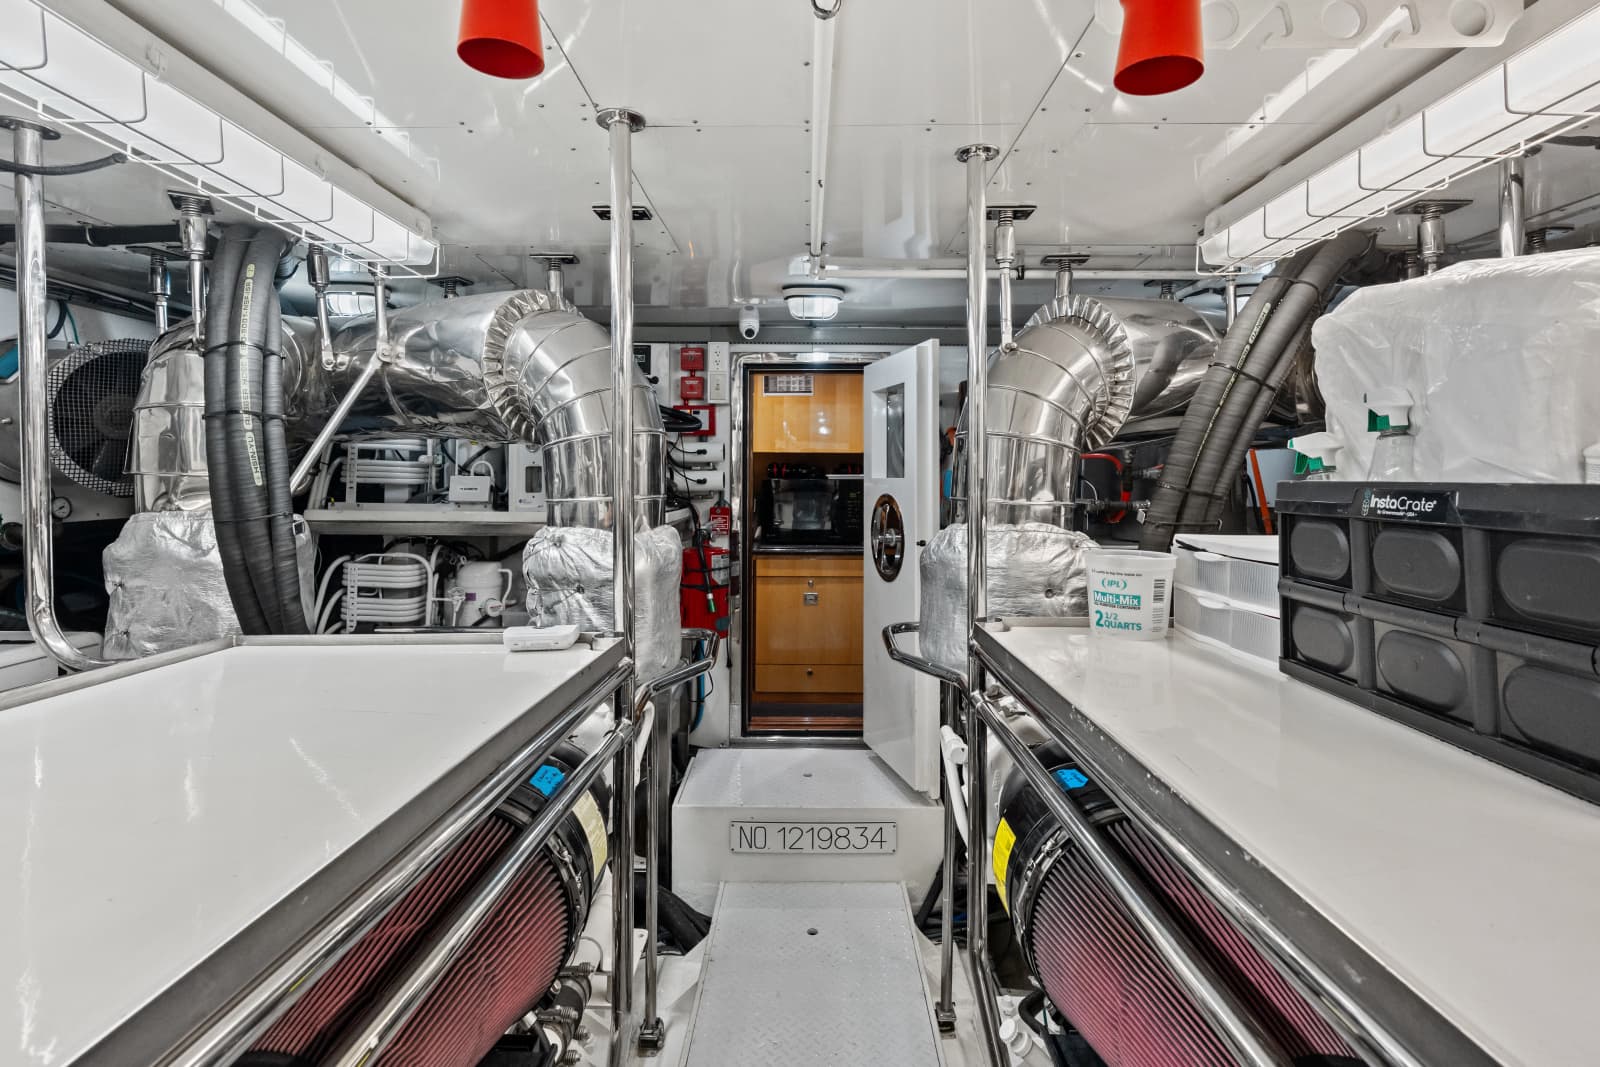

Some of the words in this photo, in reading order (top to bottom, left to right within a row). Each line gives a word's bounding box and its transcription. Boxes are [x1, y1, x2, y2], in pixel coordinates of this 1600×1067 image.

[1094, 591, 1138, 606] Multi-Mix
[1095, 610, 1104, 627] 2
[1104, 619, 1142, 631] QUARTS
[777, 826, 888, 850] 1219834
